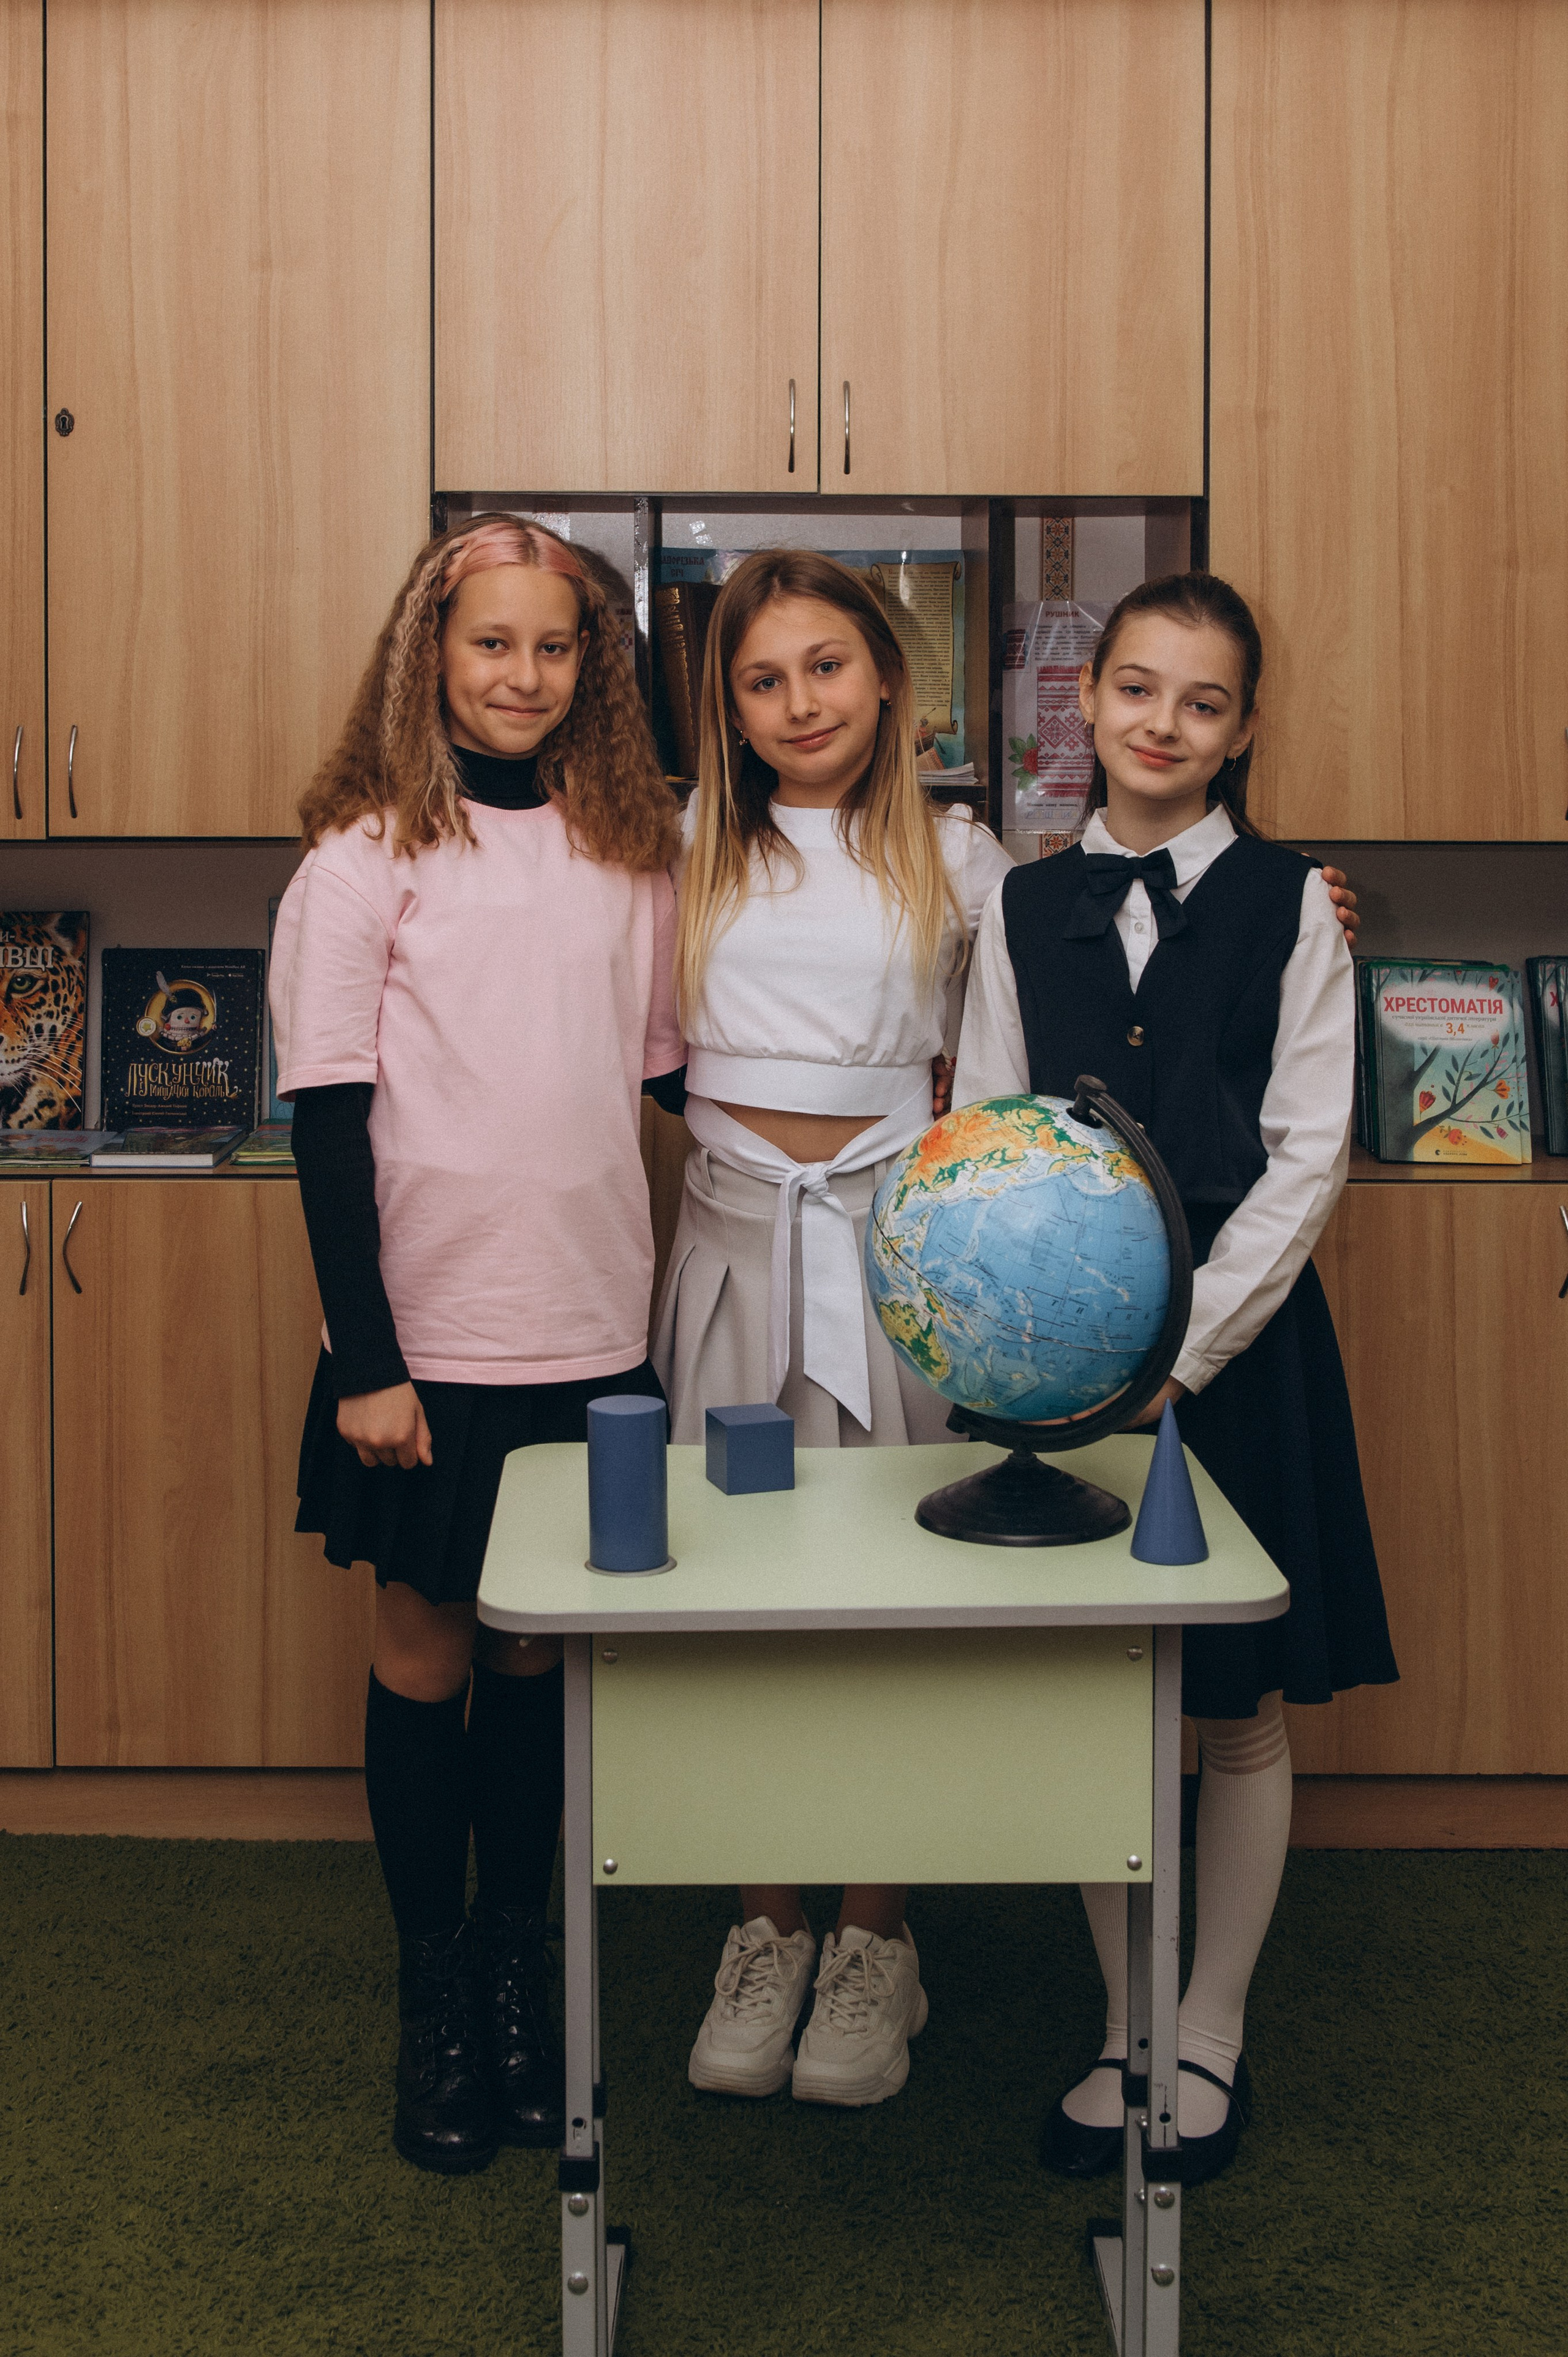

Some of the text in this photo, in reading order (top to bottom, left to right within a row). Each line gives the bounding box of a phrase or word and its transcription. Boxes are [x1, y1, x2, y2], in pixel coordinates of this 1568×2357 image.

[0, 946, 54, 971] ВЦІ
[1383, 996, 1503, 1014] ХРЕСТОМАТІЯ
[1446, 1022, 1465, 1036] 3,4
[124, 1057, 230, 1097] ЛУСКУНЧИК
[193, 1085, 225, 1098] КОРОЛЬ
